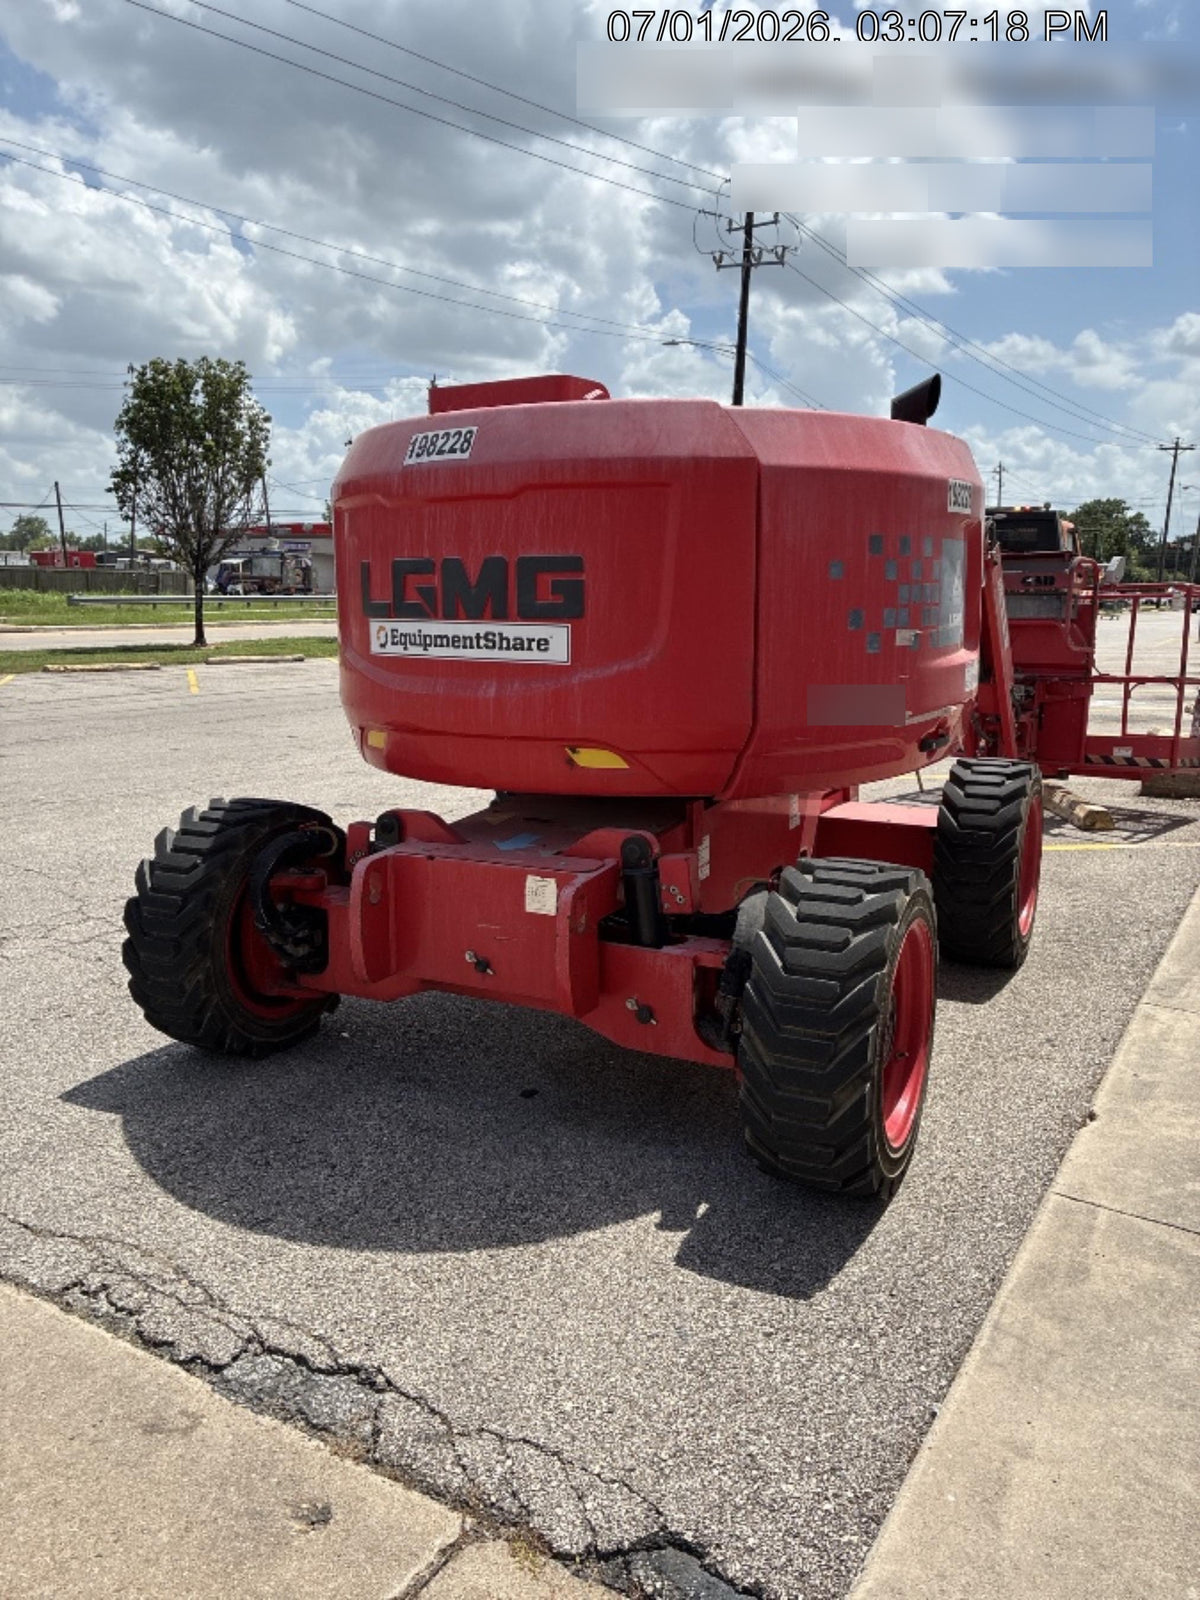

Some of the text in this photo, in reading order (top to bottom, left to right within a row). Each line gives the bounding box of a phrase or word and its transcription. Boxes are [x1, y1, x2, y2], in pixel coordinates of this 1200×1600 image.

[408, 429, 475, 459] 198228
[360, 555, 585, 619] LGMG
[390, 628, 551, 652] EquipmentShare
